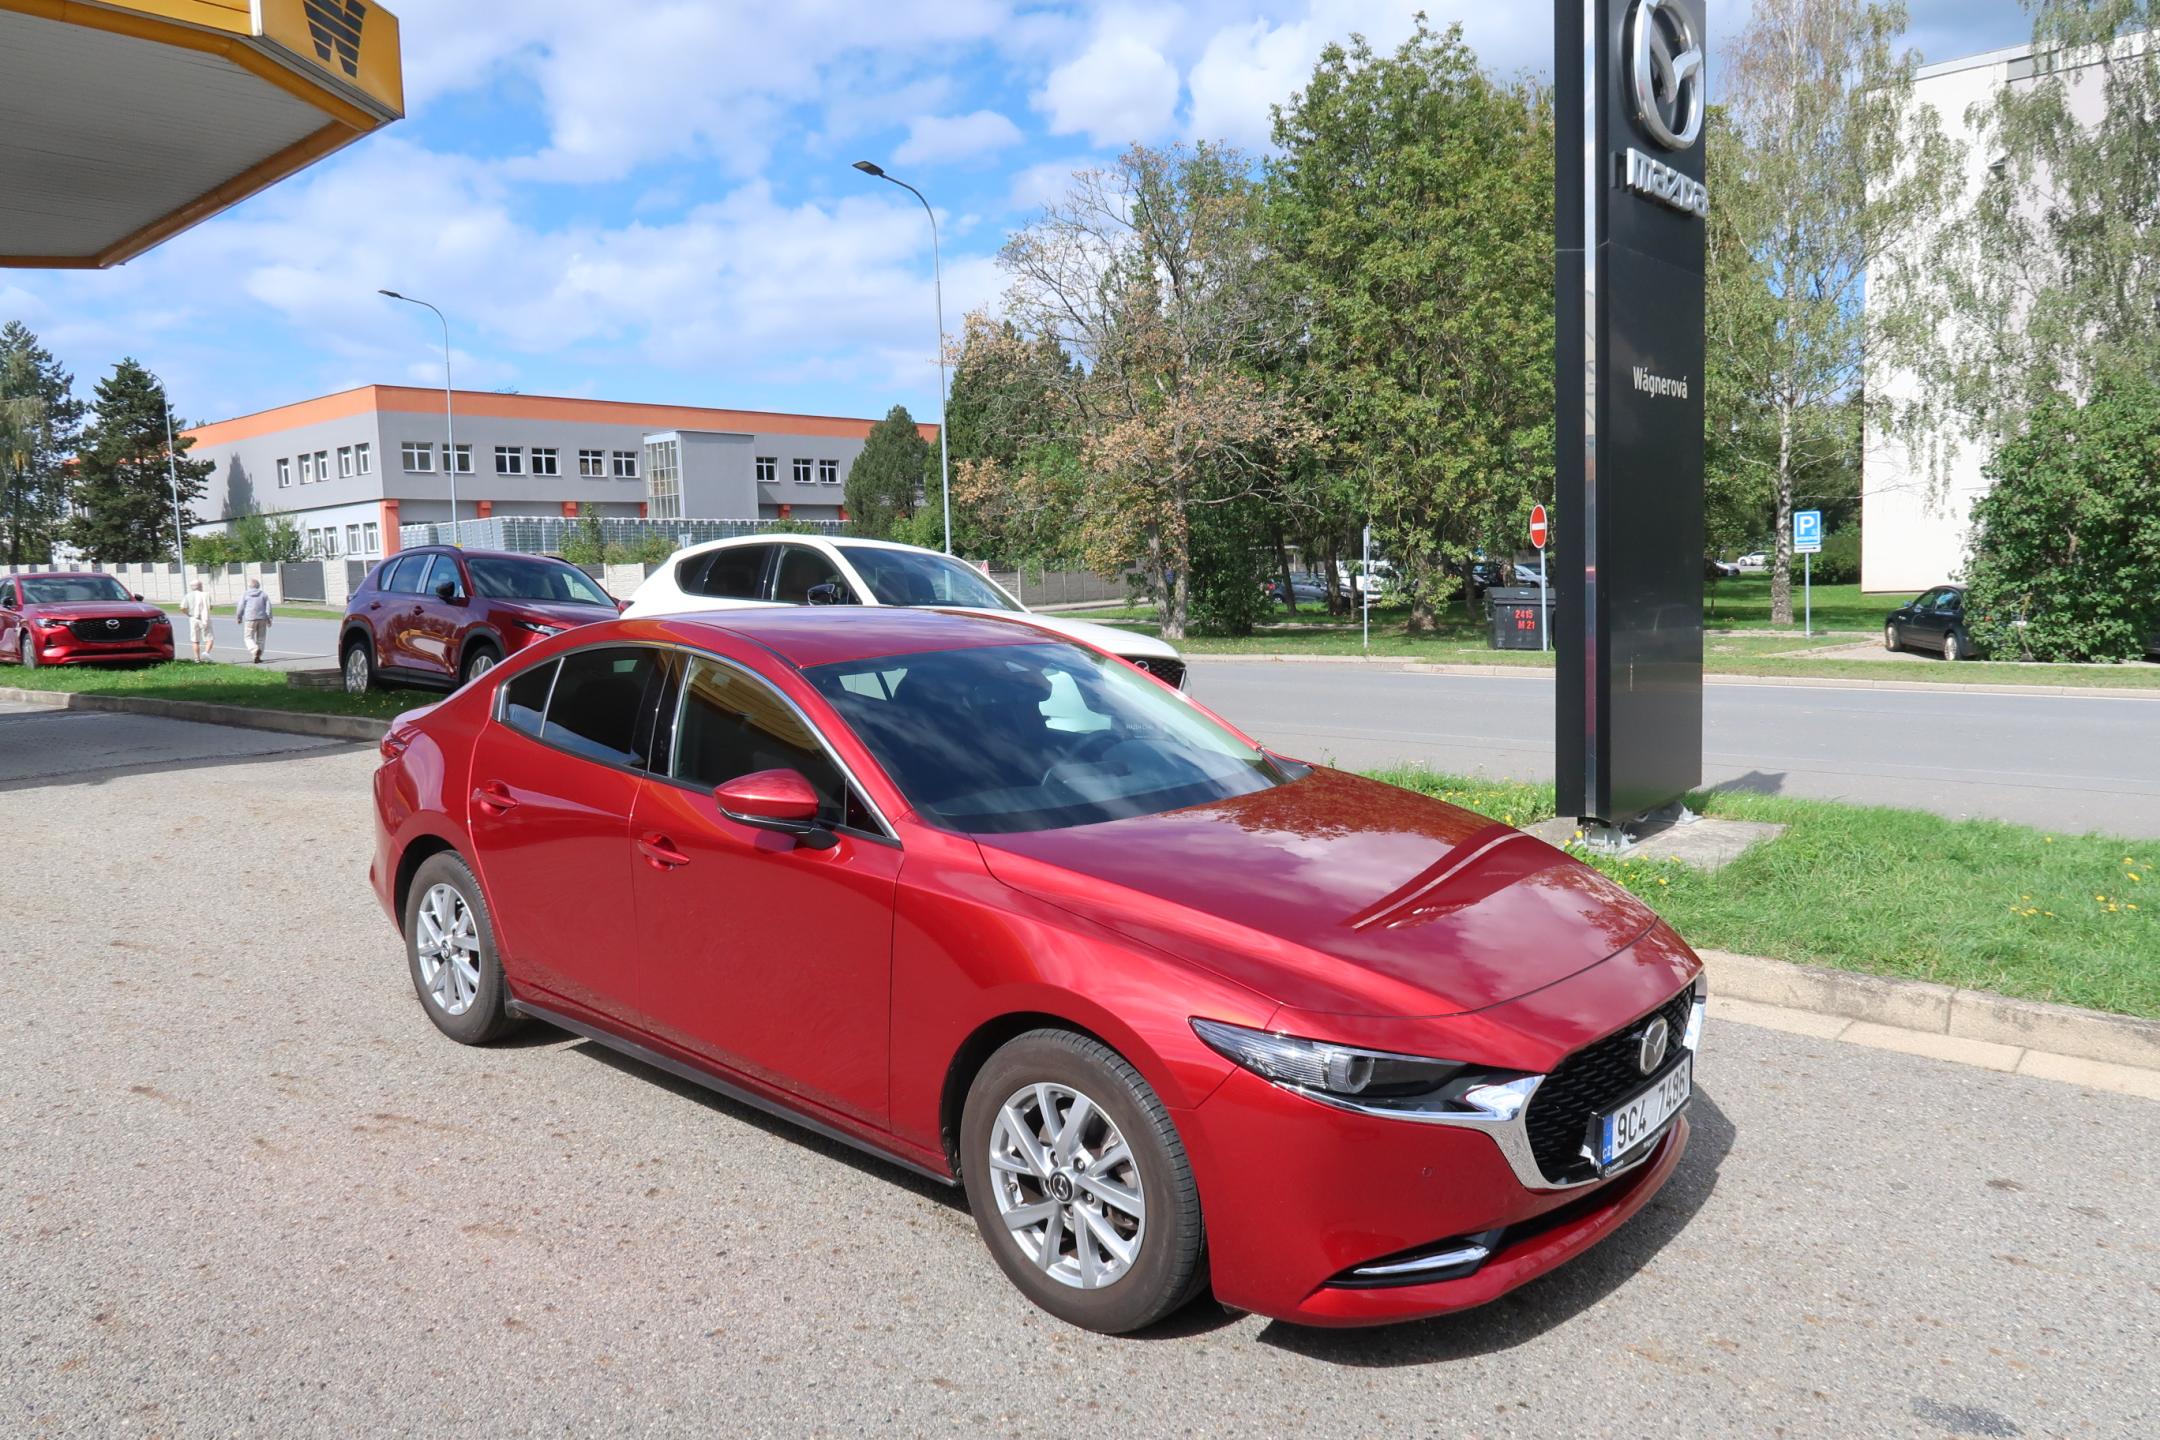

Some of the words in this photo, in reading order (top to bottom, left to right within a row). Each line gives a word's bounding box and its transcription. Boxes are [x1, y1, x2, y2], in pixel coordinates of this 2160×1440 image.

[1626, 147, 1710, 219] mazda
[1633, 366, 1688, 399] Wágnerová
[1800, 515, 1815, 535] P
[1617, 1100, 1646, 1149] 9C4
